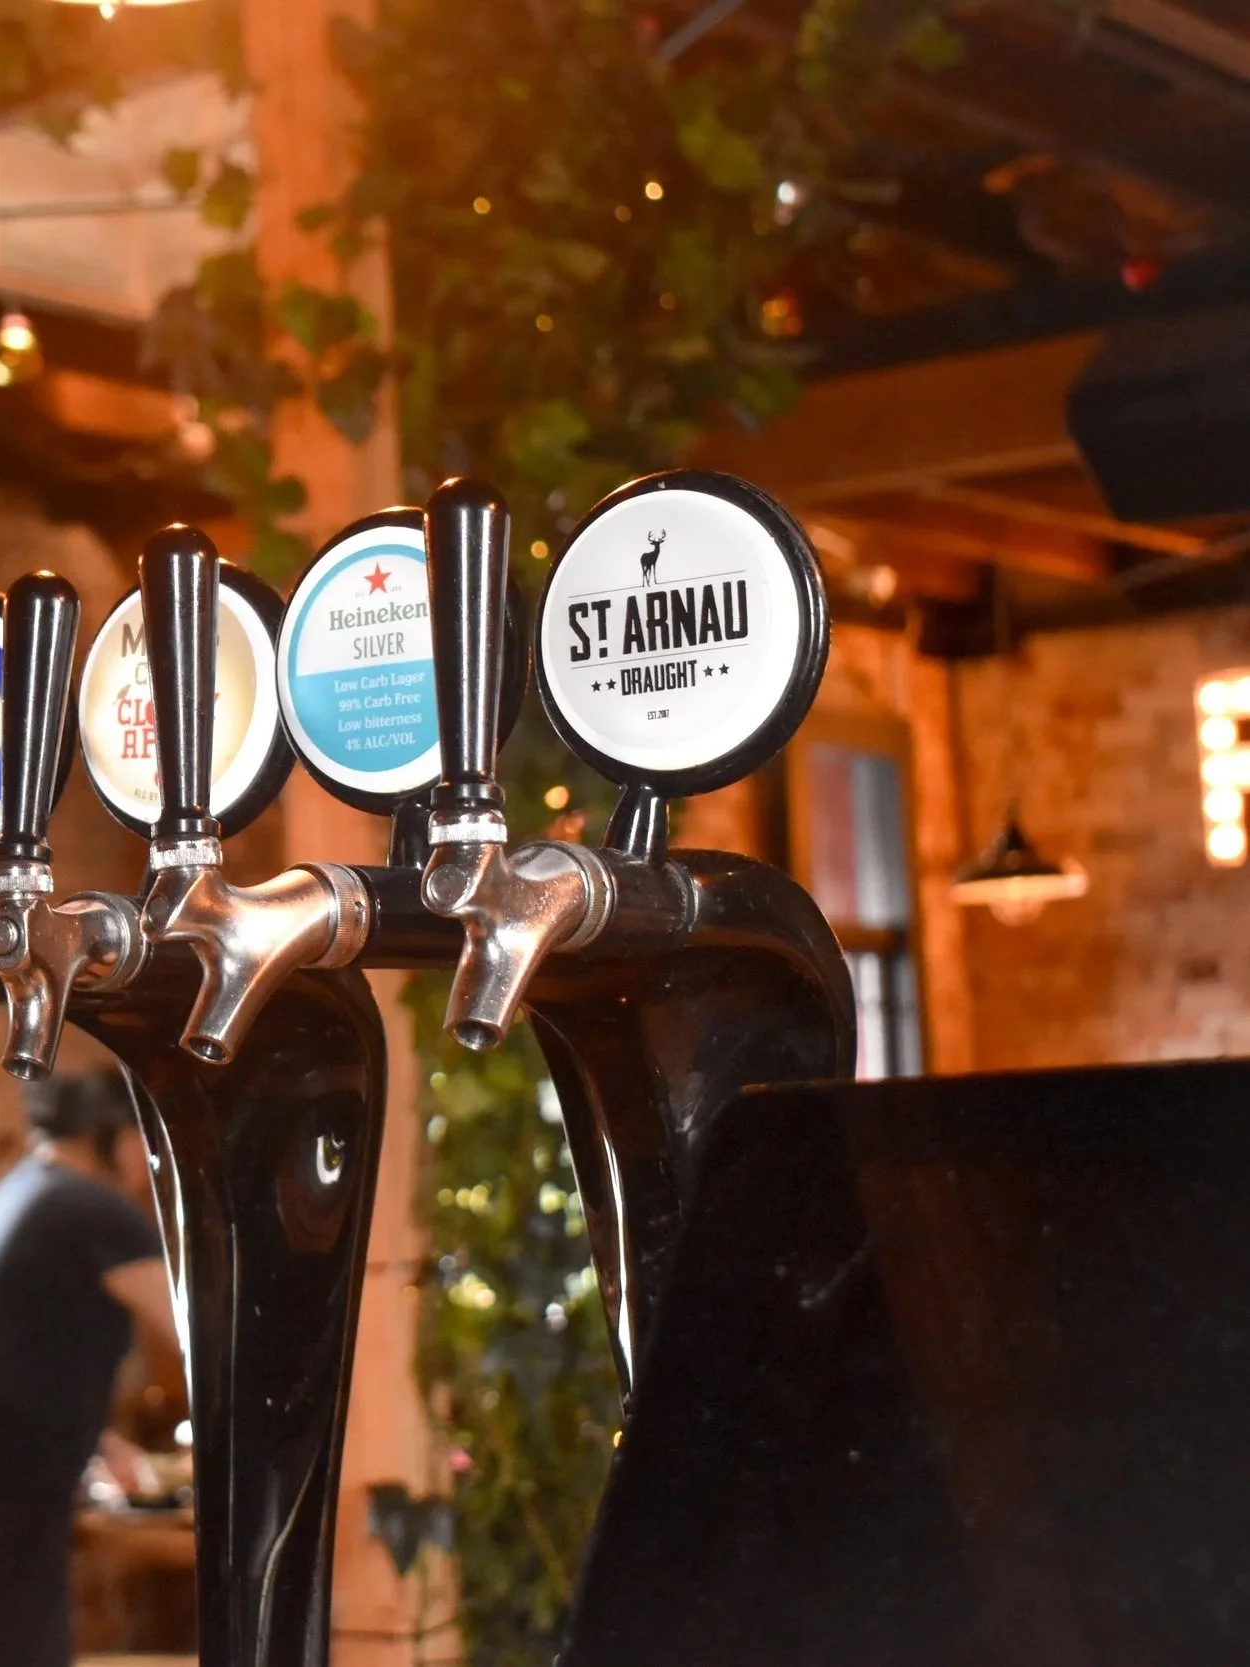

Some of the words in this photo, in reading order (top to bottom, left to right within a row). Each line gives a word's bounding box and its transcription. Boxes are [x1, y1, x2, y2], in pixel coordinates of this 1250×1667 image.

[329, 601, 428, 631] Heineken
[622, 579, 749, 655] ARNAU
[353, 632, 405, 660] SILVER
[334, 679, 359, 693] Low
[361, 674, 388, 690] Carb
[391, 672, 425, 686] Lager
[620, 659, 698, 696] DRAUGHT
[338, 698, 362, 712] 99%
[364, 694, 392, 709] Carb
[394, 692, 421, 705] Free
[338, 719, 362, 732] Low
[365, 713, 422, 729] bitterness
[345, 738, 362, 751] 4%
[363, 732, 416, 749] ALC/VOL
